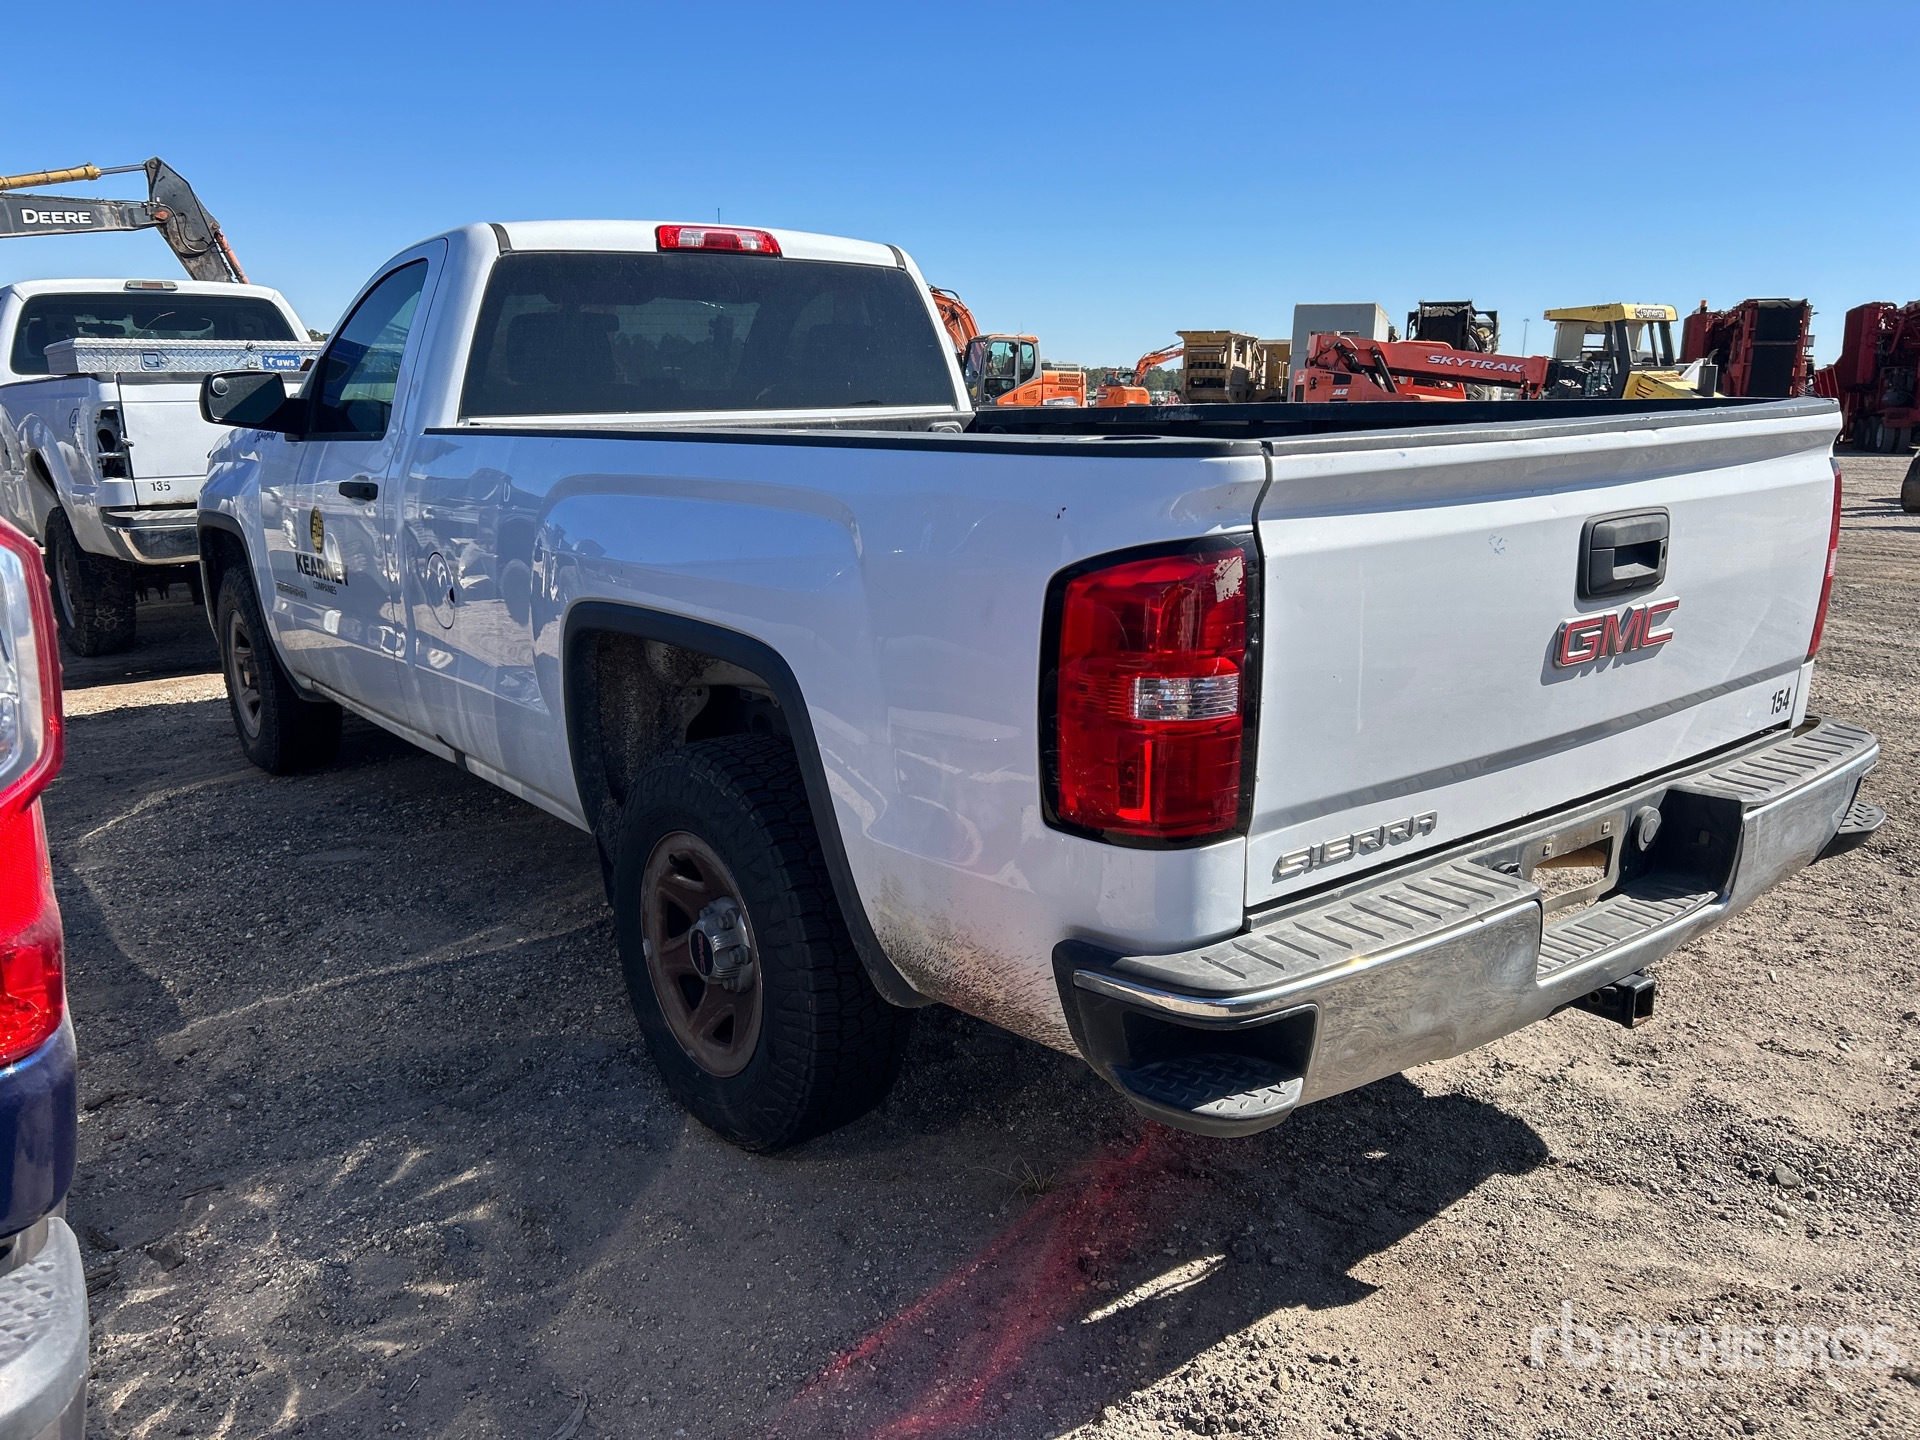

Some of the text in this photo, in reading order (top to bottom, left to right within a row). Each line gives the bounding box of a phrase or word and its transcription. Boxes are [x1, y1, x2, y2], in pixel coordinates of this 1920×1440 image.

[21, 209, 92, 224] DEERE
[276, 359, 296, 367] UWS
[1427, 355, 1525, 373] SKYTRAK
[1332, 388, 1349, 396] JLG
[150, 481, 171, 492] 135
[1552, 595, 1680, 668] GMC
[1770, 687, 1791, 715] 154
[1277, 809, 1438, 877] SIERRA
